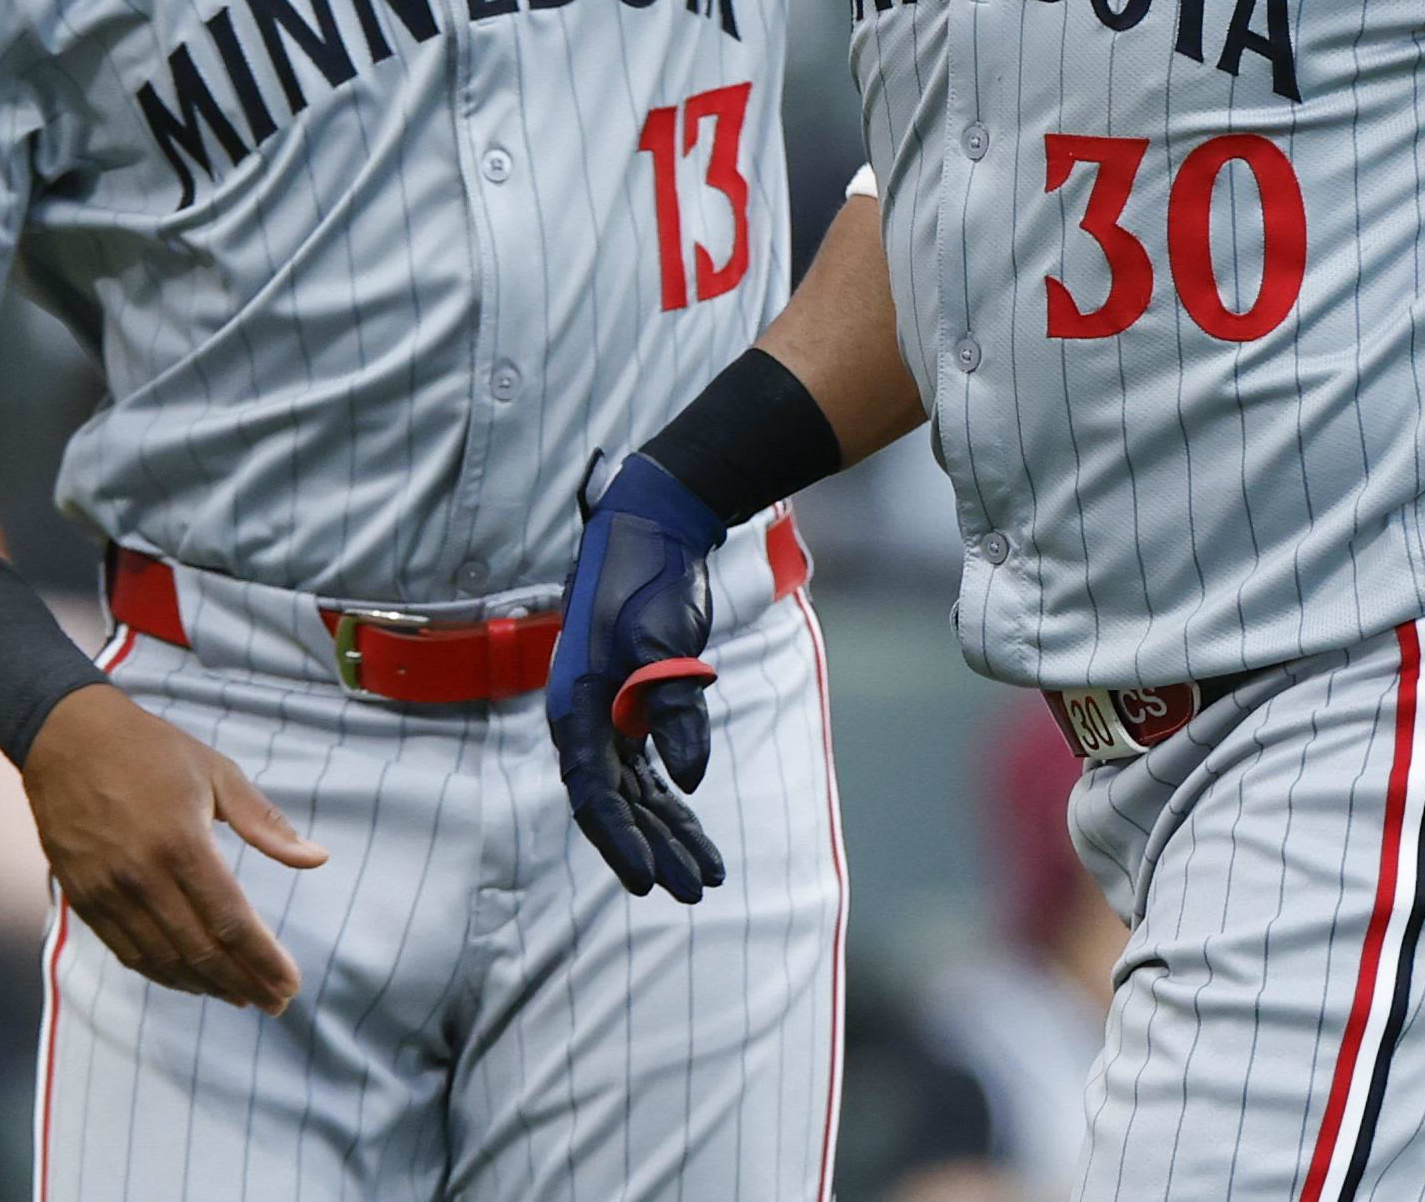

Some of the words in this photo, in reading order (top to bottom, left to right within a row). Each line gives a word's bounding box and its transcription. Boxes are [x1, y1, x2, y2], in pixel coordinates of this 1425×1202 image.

[638, 82, 753, 313] 13
[1044, 133, 1308, 342] 30
[1071, 696, 1115, 750] 30
